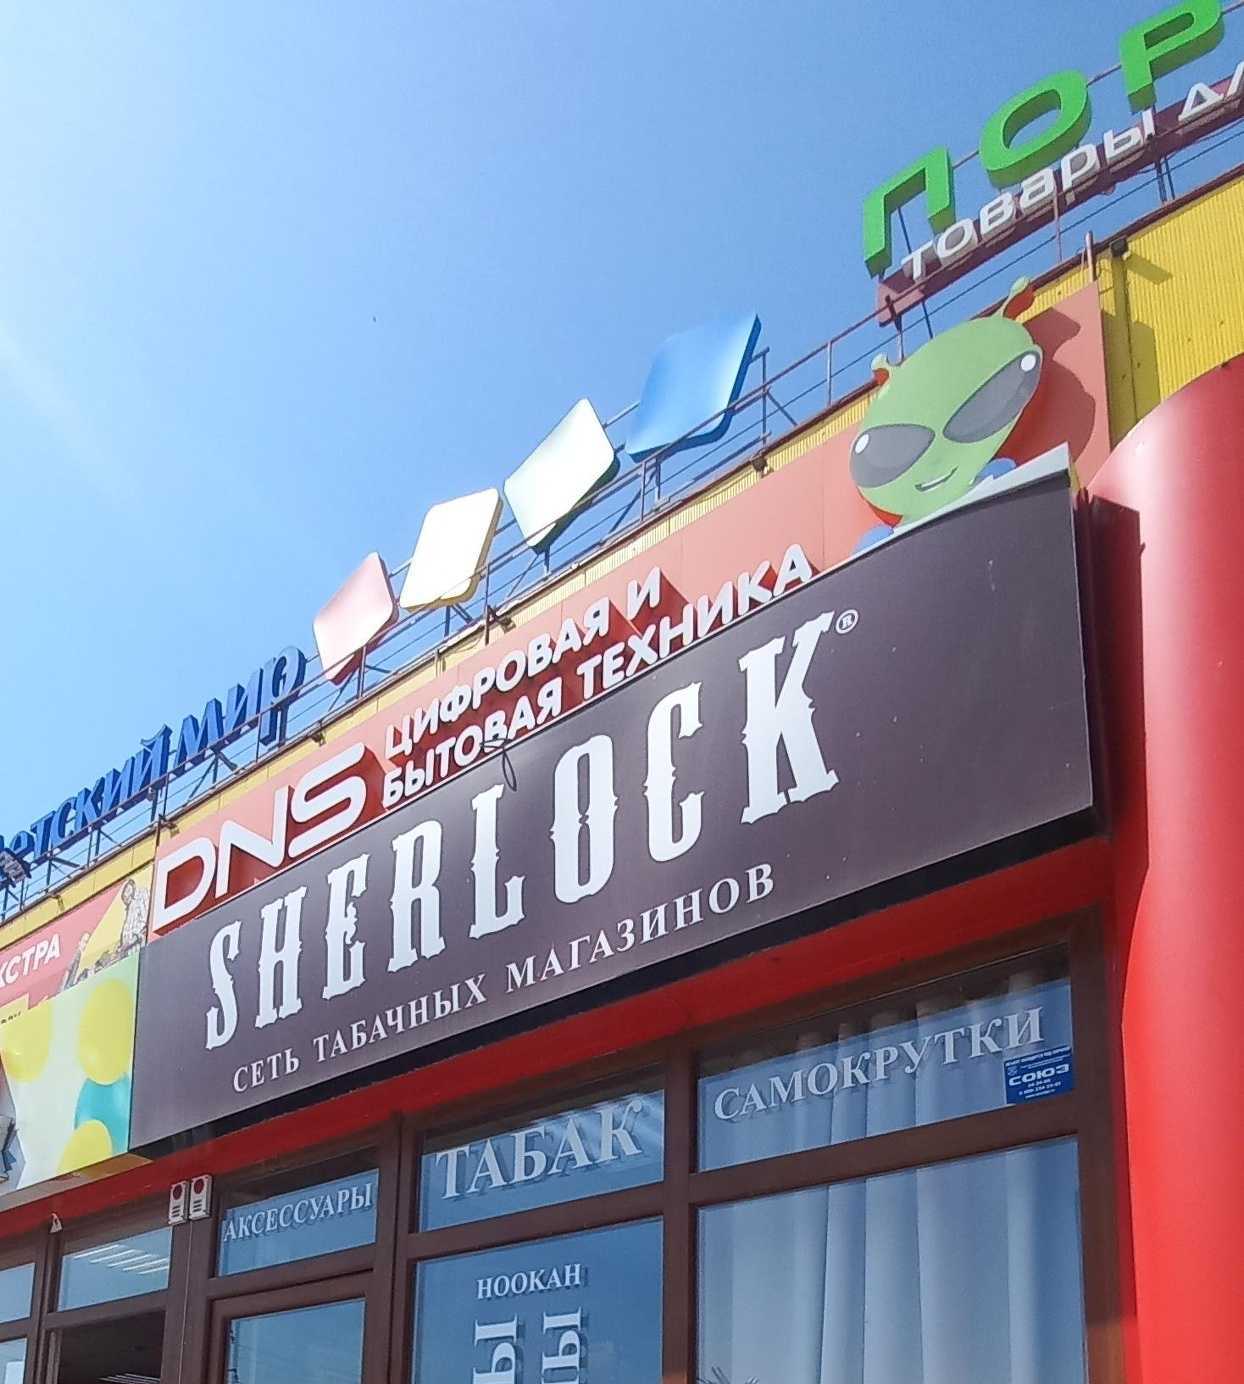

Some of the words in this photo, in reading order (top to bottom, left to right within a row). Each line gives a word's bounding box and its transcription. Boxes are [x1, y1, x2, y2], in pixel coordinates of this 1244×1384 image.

[382, 680, 563, 808] БЫТОВАЯ
[577, 543, 813, 701] ТЕХНИКА
[384, 597, 609, 759] ЦИФРОВАЯ
[627, 566, 662, 620] И
[0, 724, 173, 866] етский
[152, 742, 367, 932] DNS
[205, 610, 839, 1050] SHERLOCK
[233, 1046, 299, 1093] СЕТЬ
[313, 973, 487, 1062] ТАБАЧНЫХ
[505, 863, 775, 993] МАГАЗИНОВ
[714, 1006, 1045, 1121] САМОКРУТКИ
[222, 1182, 373, 1243] АКСЕССУАРЫ
[435, 1099, 644, 1201] ТАБАК
